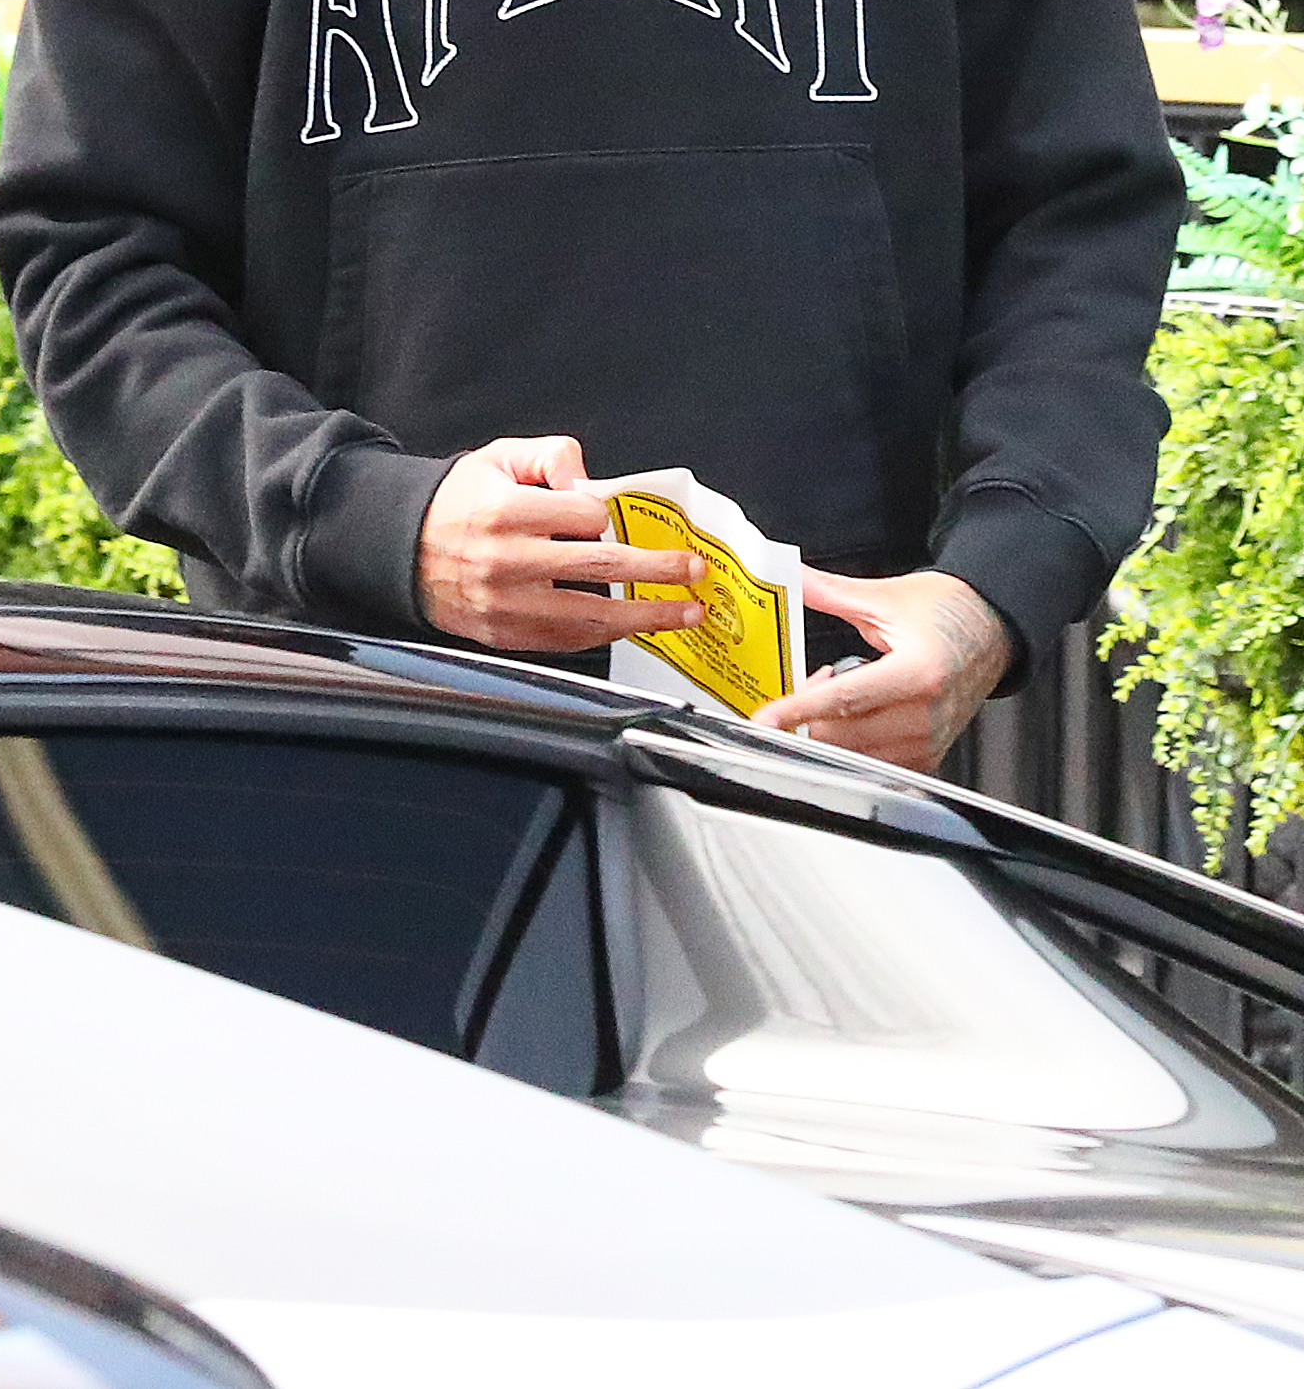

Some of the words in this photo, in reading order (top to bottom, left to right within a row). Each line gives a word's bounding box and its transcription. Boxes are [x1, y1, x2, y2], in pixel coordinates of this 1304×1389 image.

[629, 504, 684, 536] PENALTY
[685, 536, 730, 575] CHARGE
[731, 570, 767, 609] NOTICE
[708, 602, 733, 631] East
